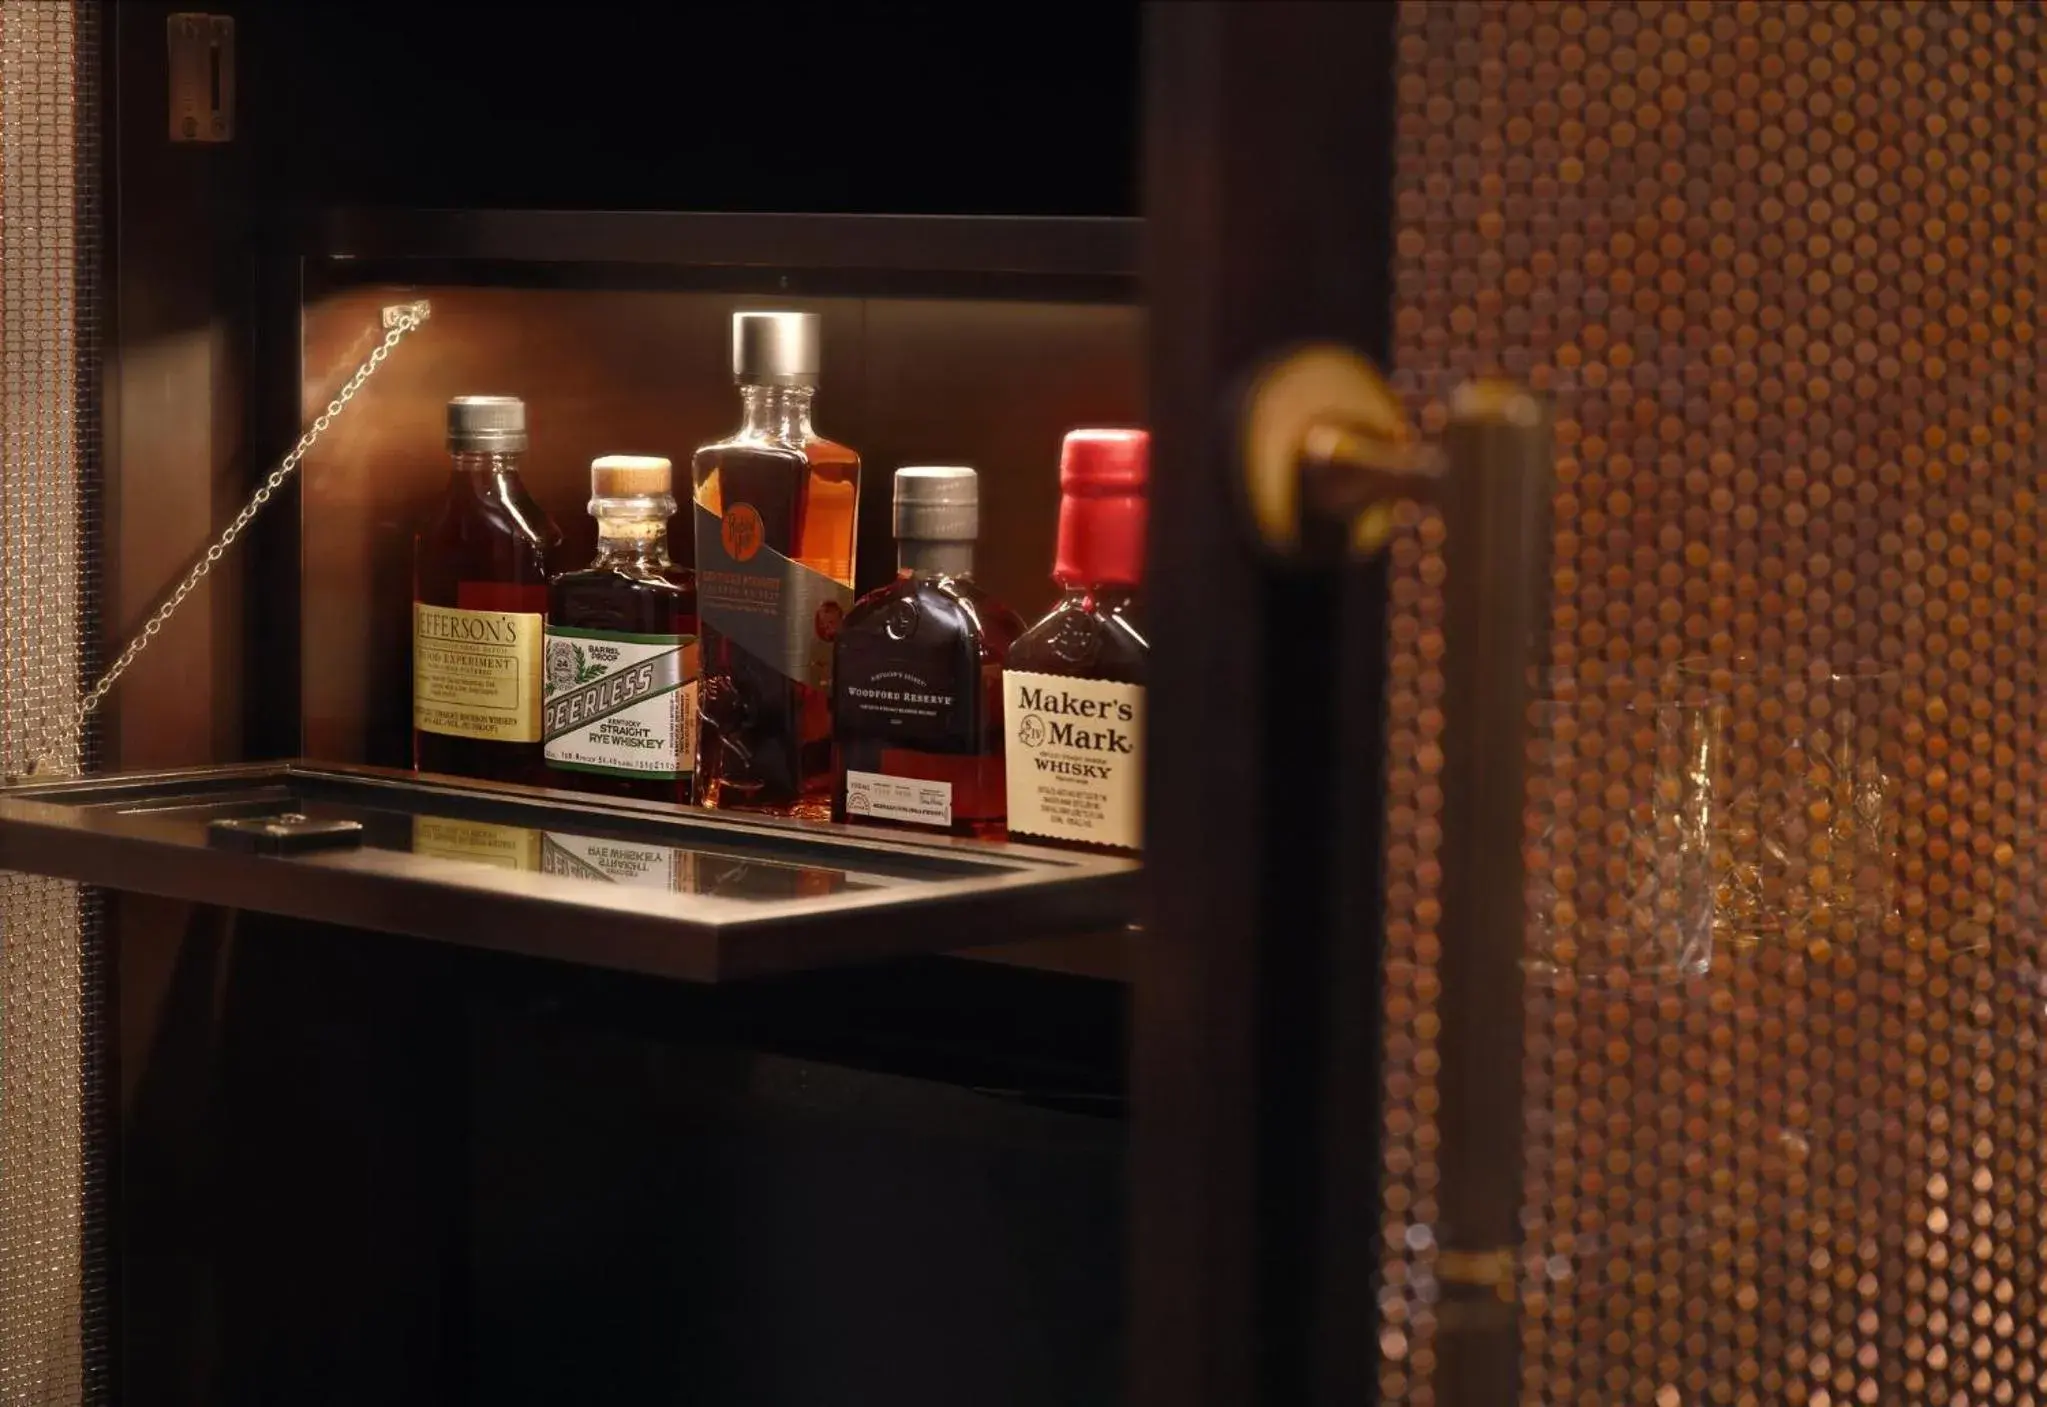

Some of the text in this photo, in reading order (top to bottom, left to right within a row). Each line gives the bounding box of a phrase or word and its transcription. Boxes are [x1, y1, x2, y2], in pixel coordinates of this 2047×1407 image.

[544, 662, 654, 731] PEERLESS
[848, 687, 952, 705] WOODFORD RESERVE
[1018, 686, 1133, 721] Maker's
[589, 733, 664, 749] RYE WHISKEY
[600, 724, 650, 738] STRAIGHT
[1034, 758, 1112, 780] WHISKY
